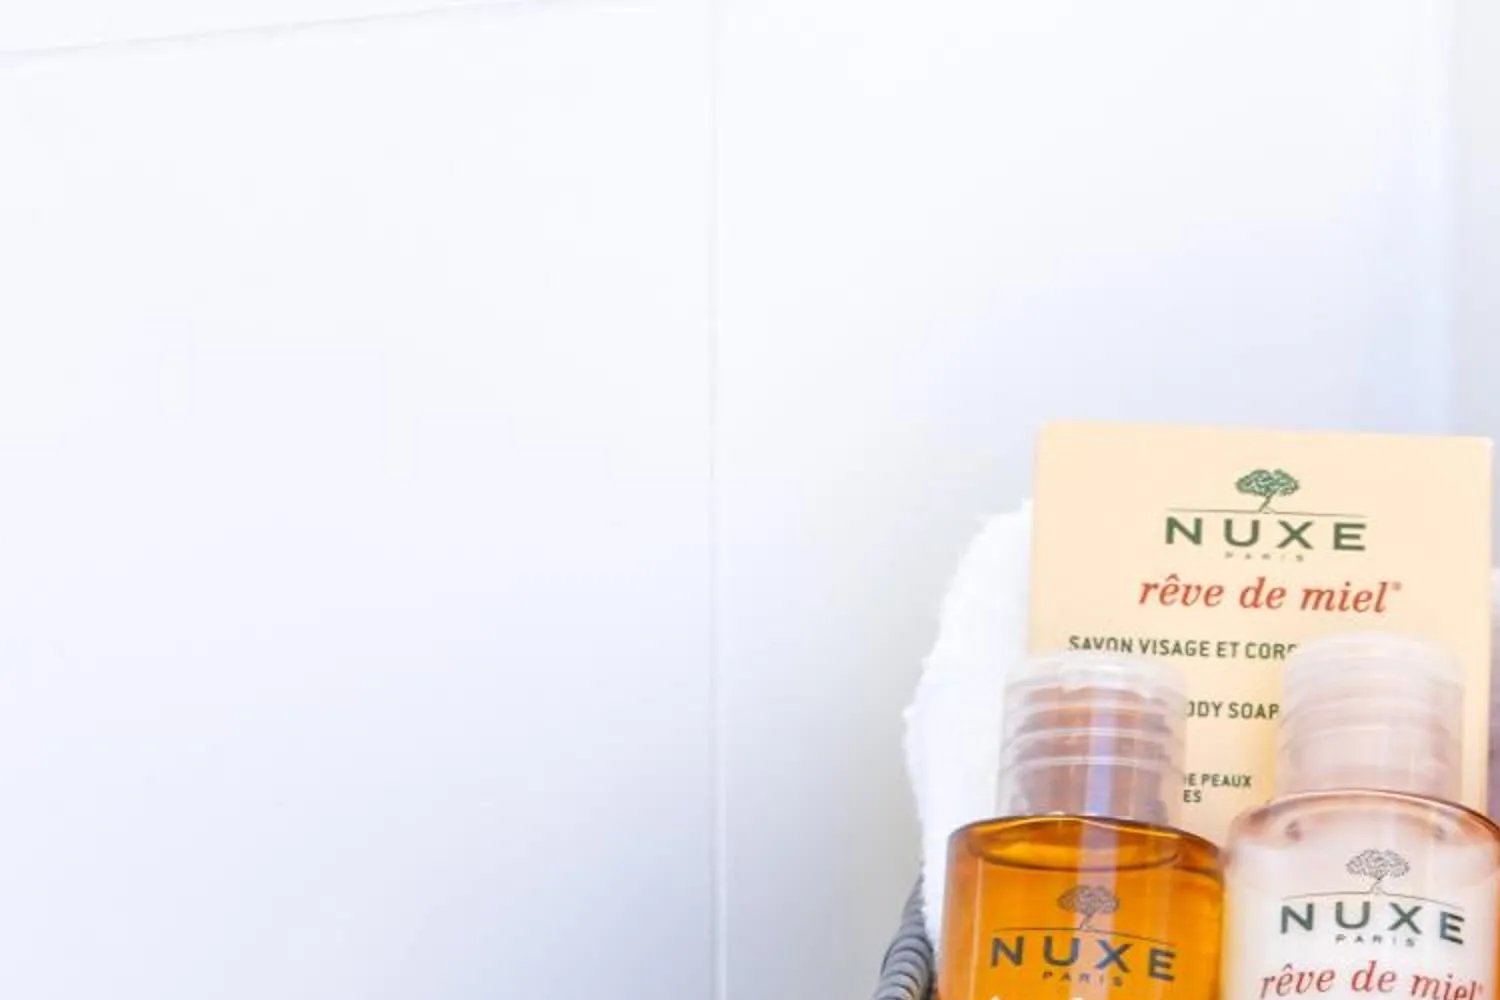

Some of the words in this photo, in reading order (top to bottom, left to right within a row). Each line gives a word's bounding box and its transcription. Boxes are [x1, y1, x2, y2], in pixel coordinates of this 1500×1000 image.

[1165, 516, 1368, 551] NUXE
[1138, 573, 1225, 608] rêve
[1238, 575, 1287, 609] de
[1068, 635, 1133, 653] SAVON
[1138, 638, 1211, 657] VISAGE
[1216, 641, 1241, 658] ET
[1244, 642, 1298, 661] COR
[1186, 700, 1223, 717] ODY
[1227, 702, 1281, 720] SOAP
[1201, 773, 1252, 788] PEAUX
[1279, 900, 1466, 945] NUXE
[1335, 933, 1416, 948] PARIS
[990, 935, 1177, 982] NUXE
[1042, 971, 1124, 988] PARIS
[1259, 962, 1336, 1000] rêve
[1350, 959, 1398, 994] de
